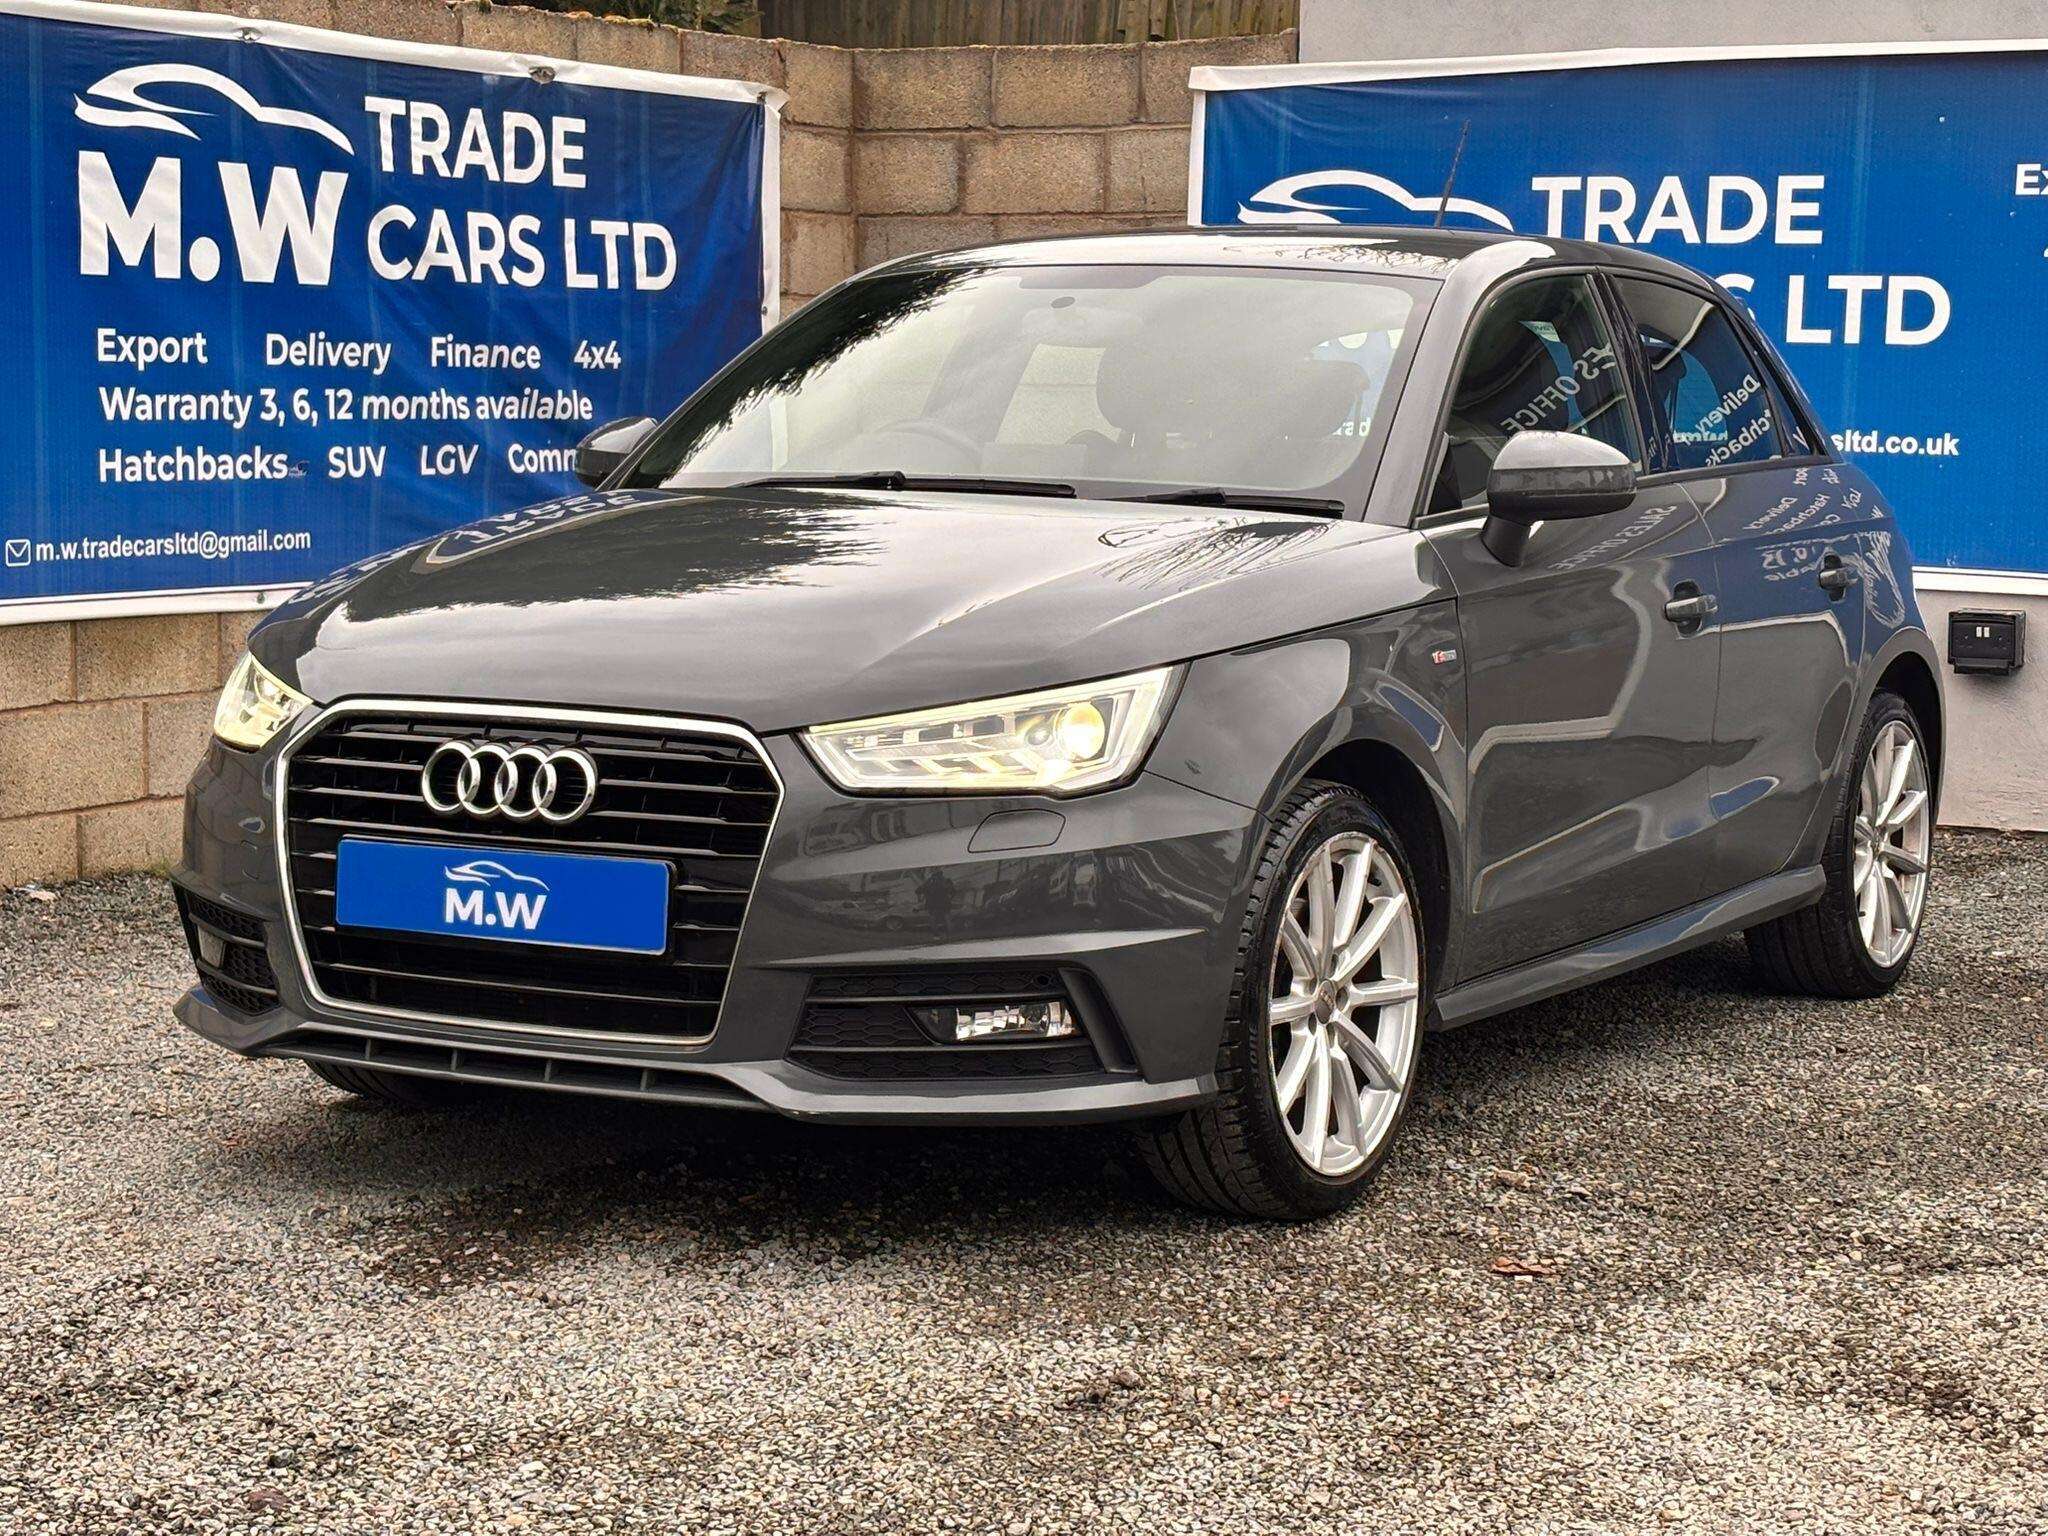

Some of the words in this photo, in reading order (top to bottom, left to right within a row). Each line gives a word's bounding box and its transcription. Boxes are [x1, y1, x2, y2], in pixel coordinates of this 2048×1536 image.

[365, 97, 587, 189] TRADE
[78, 150, 349, 286] M.W
[1531, 175, 1825, 245] TRADE
[368, 205, 545, 287] CARS
[565, 219, 678, 291] LTD
[1786, 275, 1954, 346] LTD
[97, 329, 208, 371] Export
[266, 332, 391, 375] Delivery
[431, 334, 541, 370] Finance
[574, 341, 622, 370] 4x4
[100, 387, 252, 429] Warranty
[260, 388, 286, 427] 3,
[293, 389, 318, 427] 6,
[325, 389, 353, 420] 12
[361, 389, 470, 420] months
[475, 389, 594, 421] available
[99, 446, 288, 483] Hatchbacks
[328, 447, 386, 479] SUV
[420, 445, 479, 476] LGV
[35, 530, 312, 563] m.w.tradecarsltd@gmail.com
[445, 888, 547, 931] M.W
